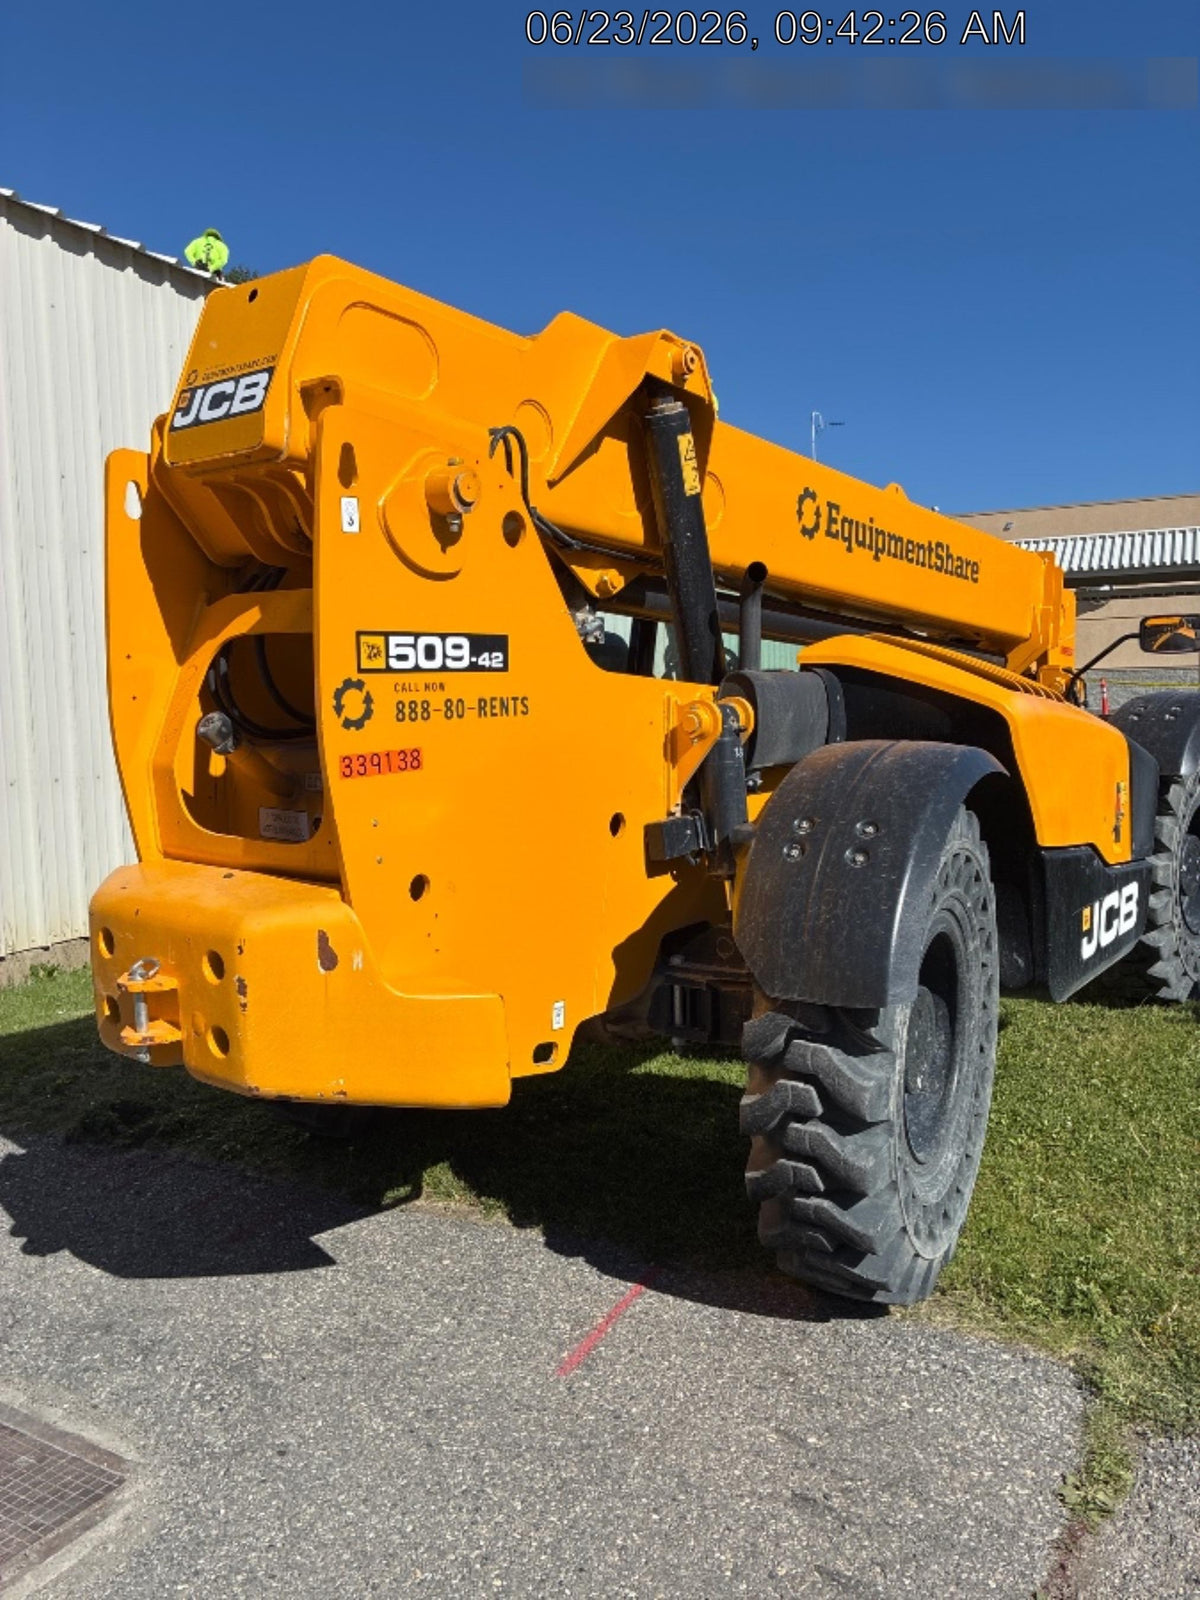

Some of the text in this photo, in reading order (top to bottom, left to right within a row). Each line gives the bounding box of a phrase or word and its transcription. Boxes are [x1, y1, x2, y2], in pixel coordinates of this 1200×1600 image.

[173, 372, 270, 428] JCB
[825, 501, 980, 583] EquipmentShare
[388, 636, 504, 669] 509-42
[395, 696, 529, 722] 888-80-RENTS
[341, 749, 421, 778] 339138
[1081, 881, 1139, 960] JCB
